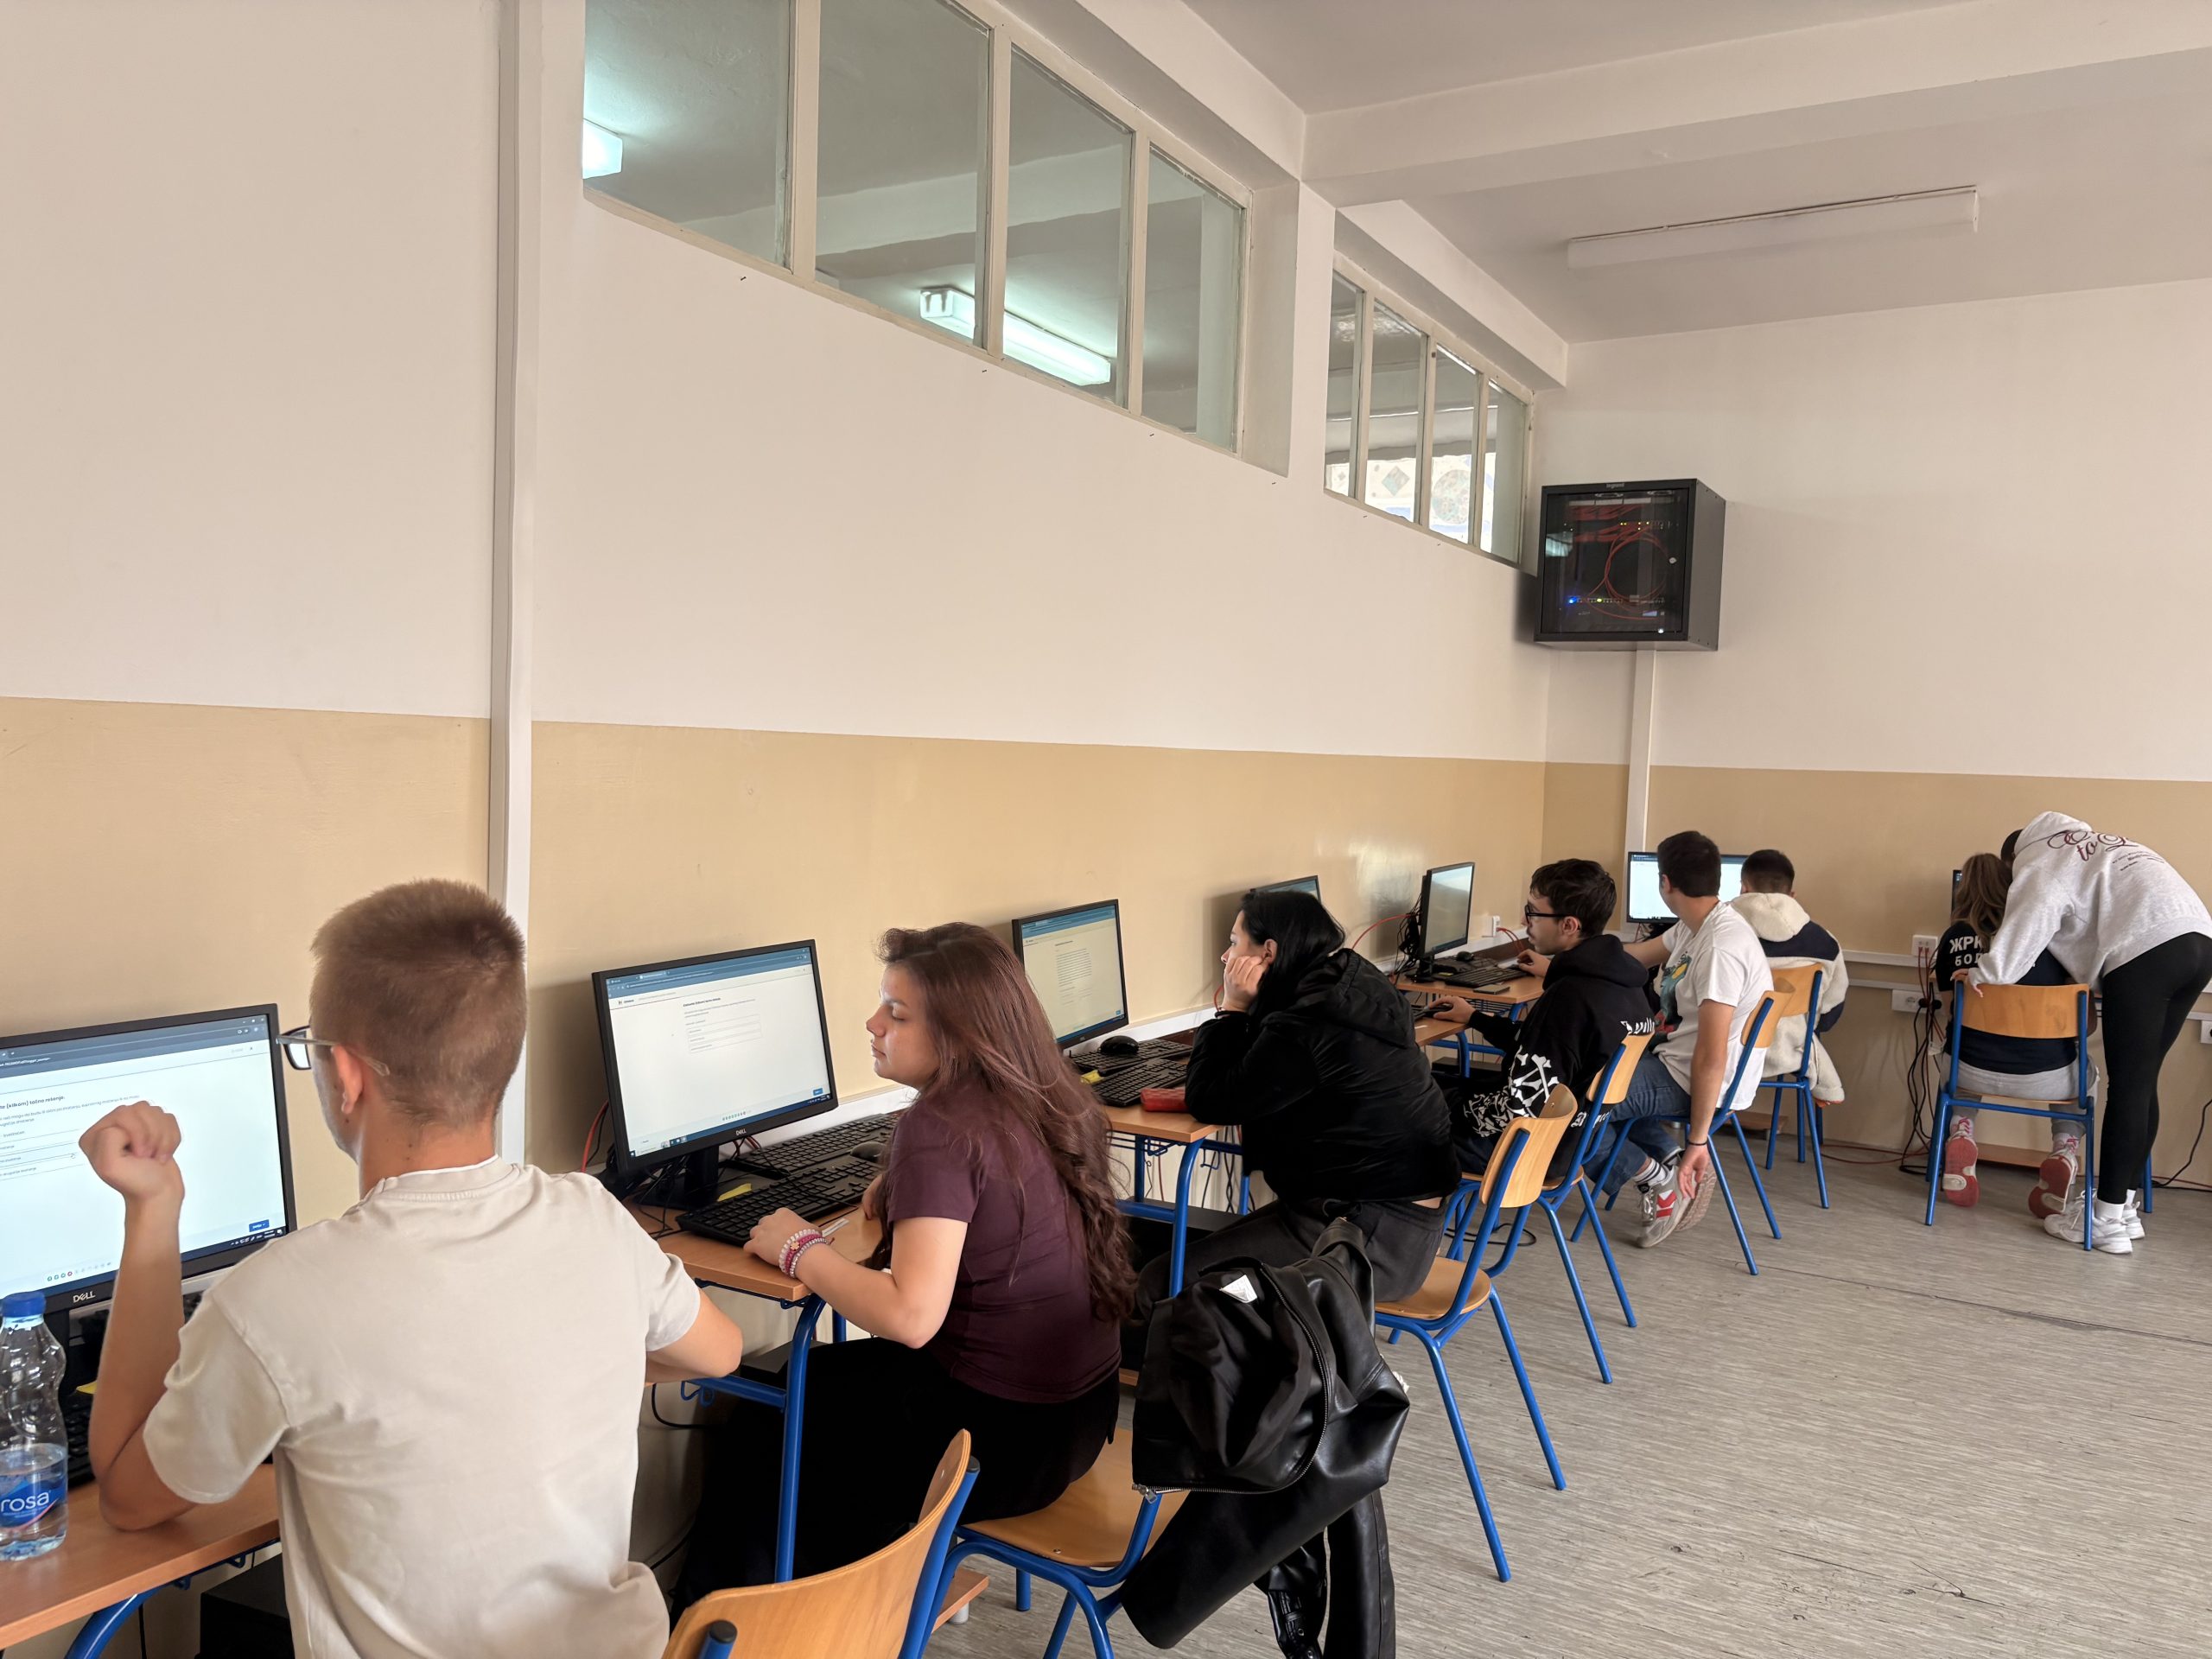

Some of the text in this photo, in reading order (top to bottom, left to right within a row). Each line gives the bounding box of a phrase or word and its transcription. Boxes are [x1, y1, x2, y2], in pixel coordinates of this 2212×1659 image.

[2076, 841, 2098, 861] to
[735, 1128, 747, 1136] DELL
[73, 1290, 96, 1303] DELL
[1, 1491, 49, 1512] rosa
